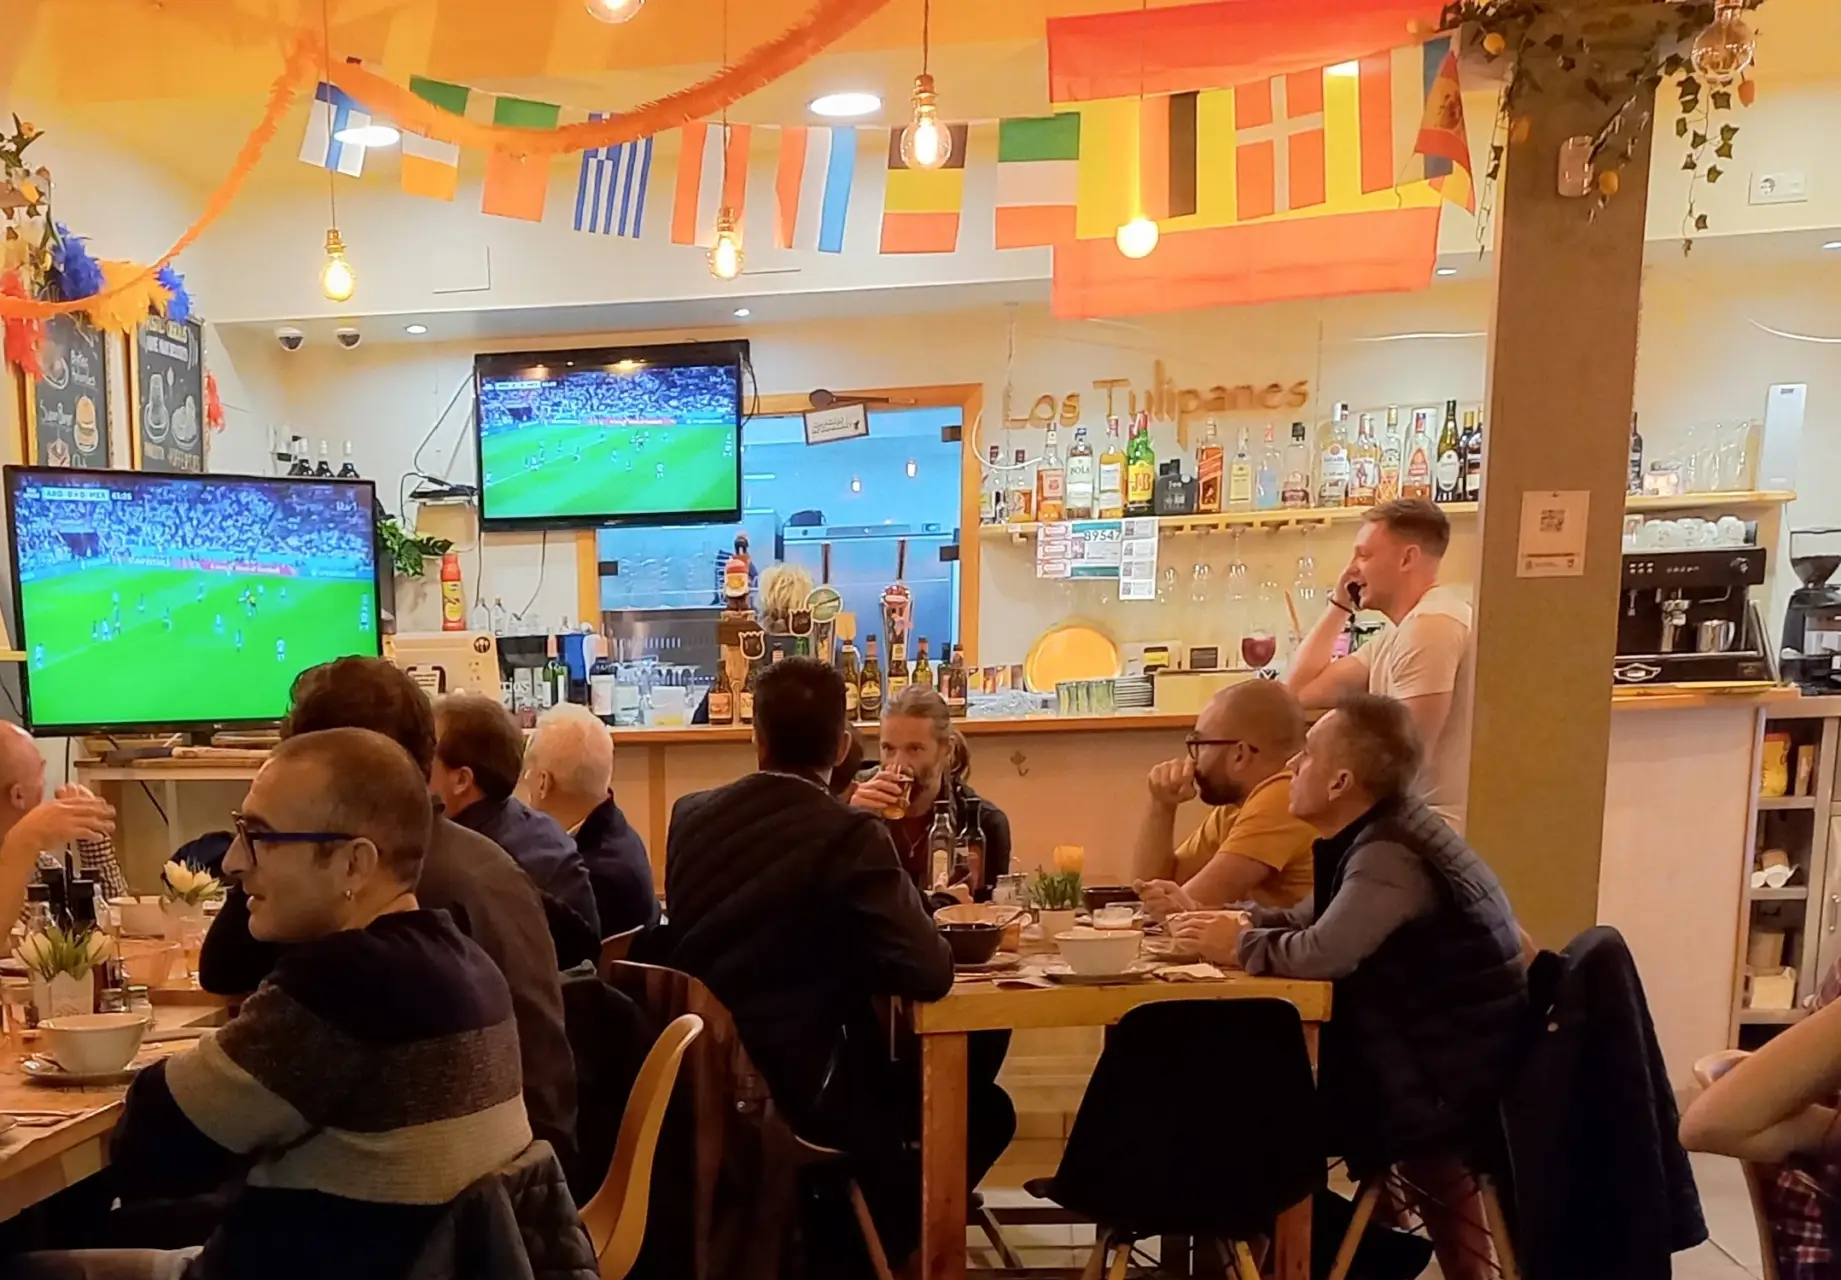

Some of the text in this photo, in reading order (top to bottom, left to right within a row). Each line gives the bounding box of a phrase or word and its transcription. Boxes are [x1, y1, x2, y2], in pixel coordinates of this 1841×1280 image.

[1001, 359, 1309, 452] Los Tulipanes
[1084, 529, 1122, 542] 89547
